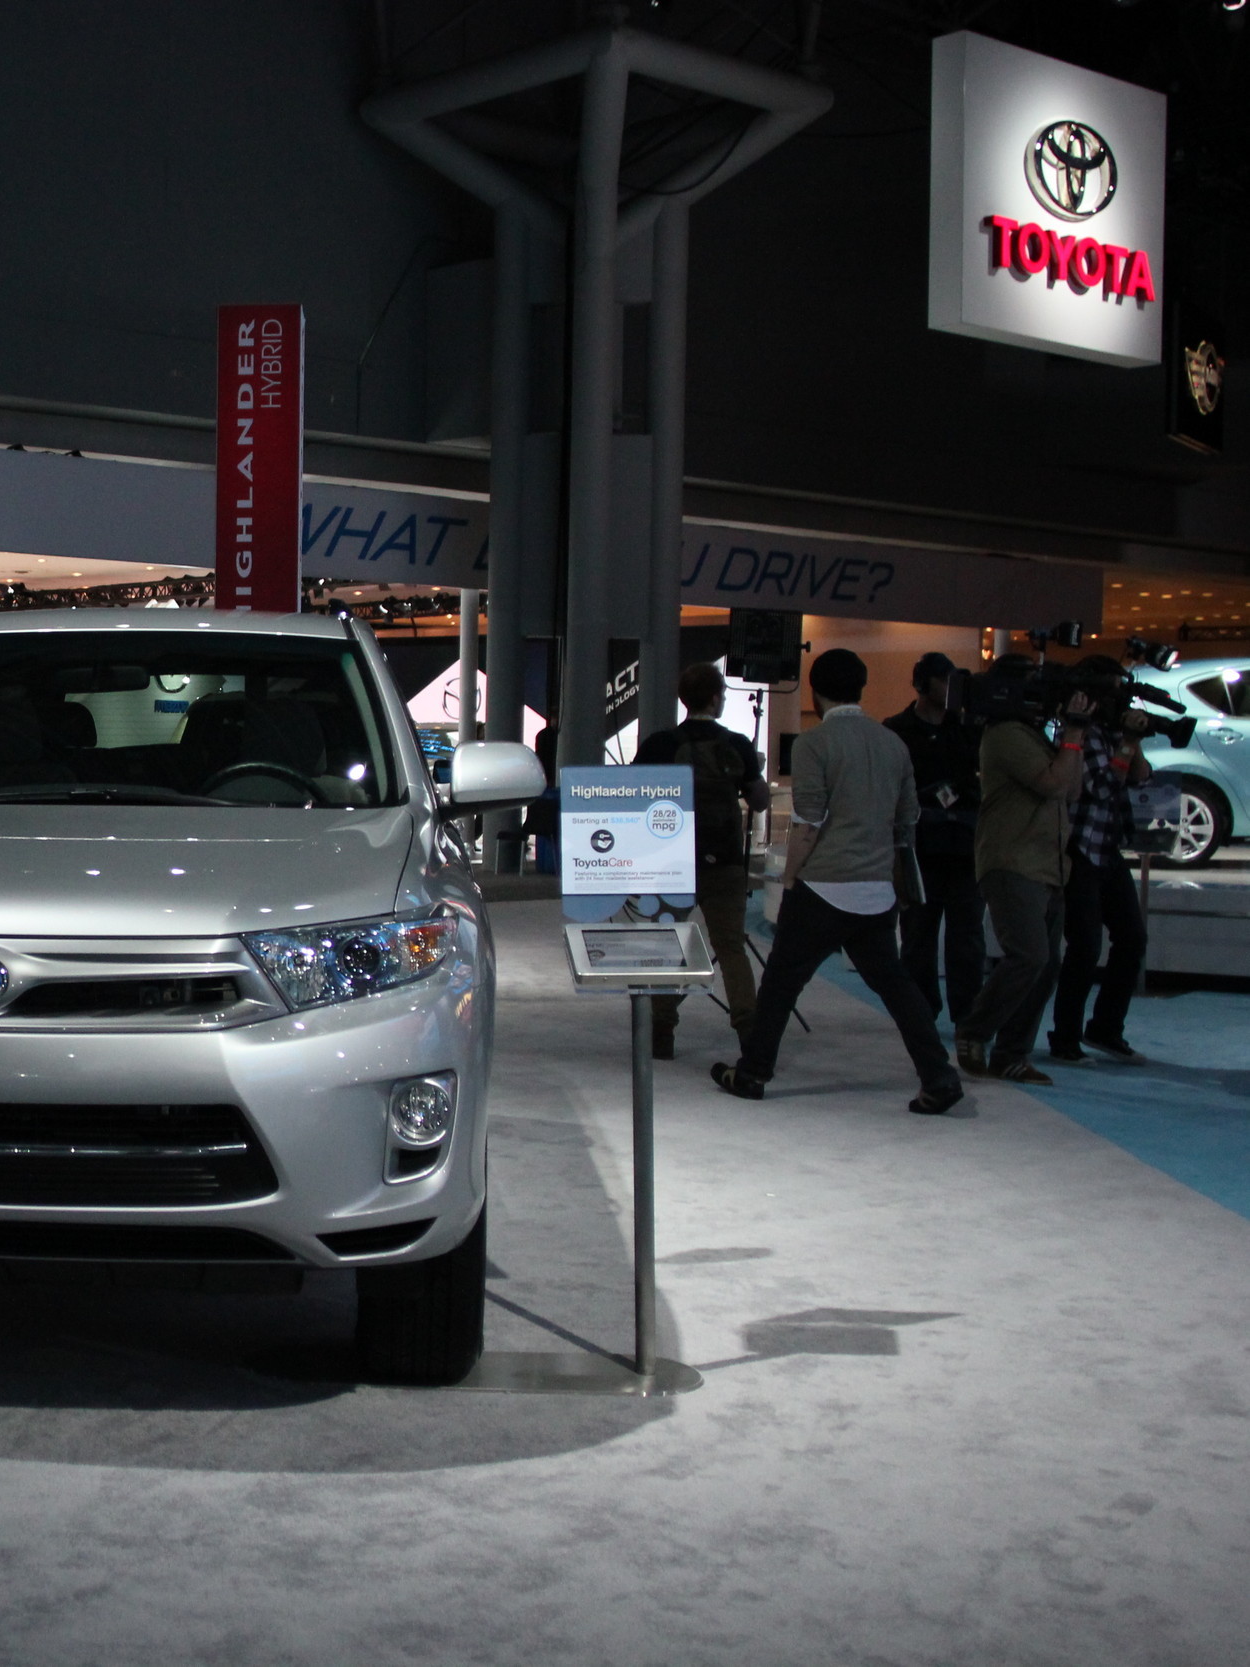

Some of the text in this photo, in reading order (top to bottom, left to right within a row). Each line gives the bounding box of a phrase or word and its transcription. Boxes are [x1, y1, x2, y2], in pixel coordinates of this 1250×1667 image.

[984, 215, 1156, 302] TOYOTA
[261, 318, 283, 408] HYBRID
[235, 318, 255, 610] IGHLANDER
[715, 547, 895, 603] DRIVE?
[571, 785, 681, 799] Highlander Hybrid
[572, 817, 600, 825] Starting
[652, 810, 677, 819] 28/28
[573, 857, 633, 869] ToyotaCare
